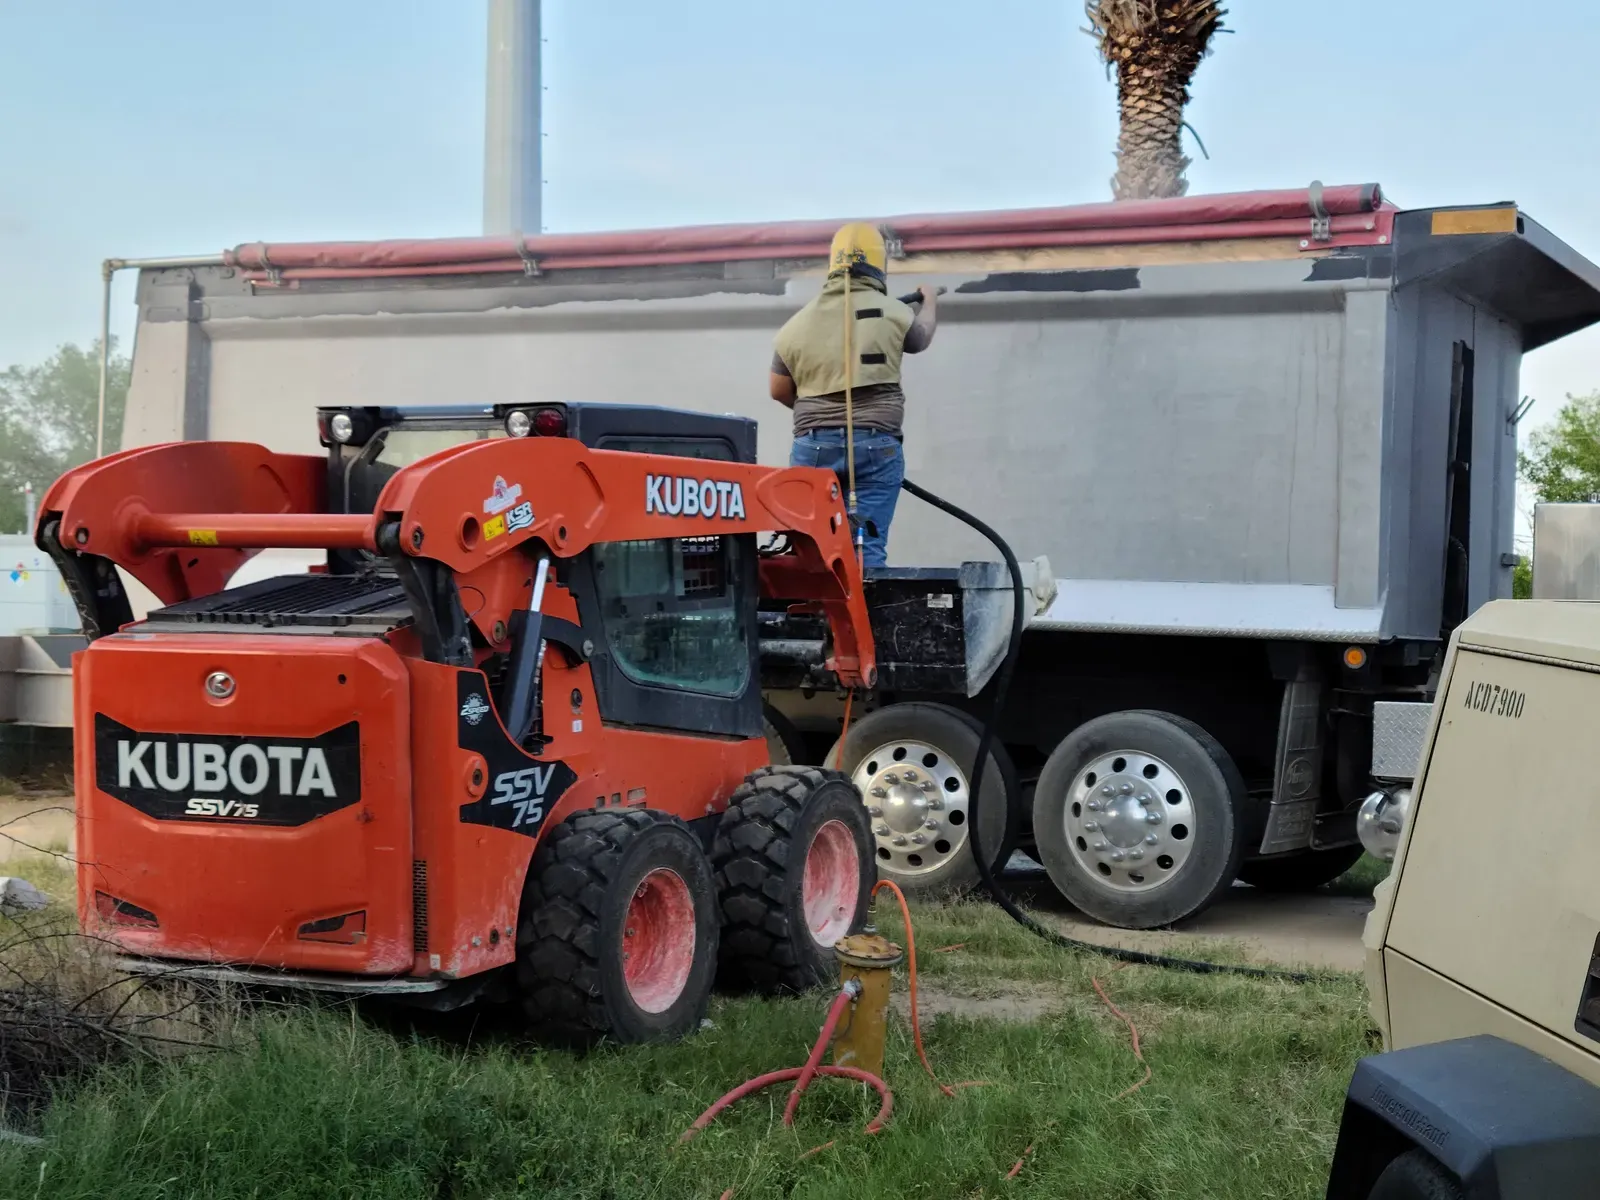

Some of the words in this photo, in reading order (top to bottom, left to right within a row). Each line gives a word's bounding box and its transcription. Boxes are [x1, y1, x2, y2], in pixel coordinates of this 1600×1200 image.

[506, 501, 533, 526] KSR
[646, 474, 746, 519] KUBOTA
[1464, 681, 1526, 718] ACD7900
[117, 739, 338, 798] KUBOTA
[490, 763, 557, 806] SSV
[511, 797, 544, 828] 75
